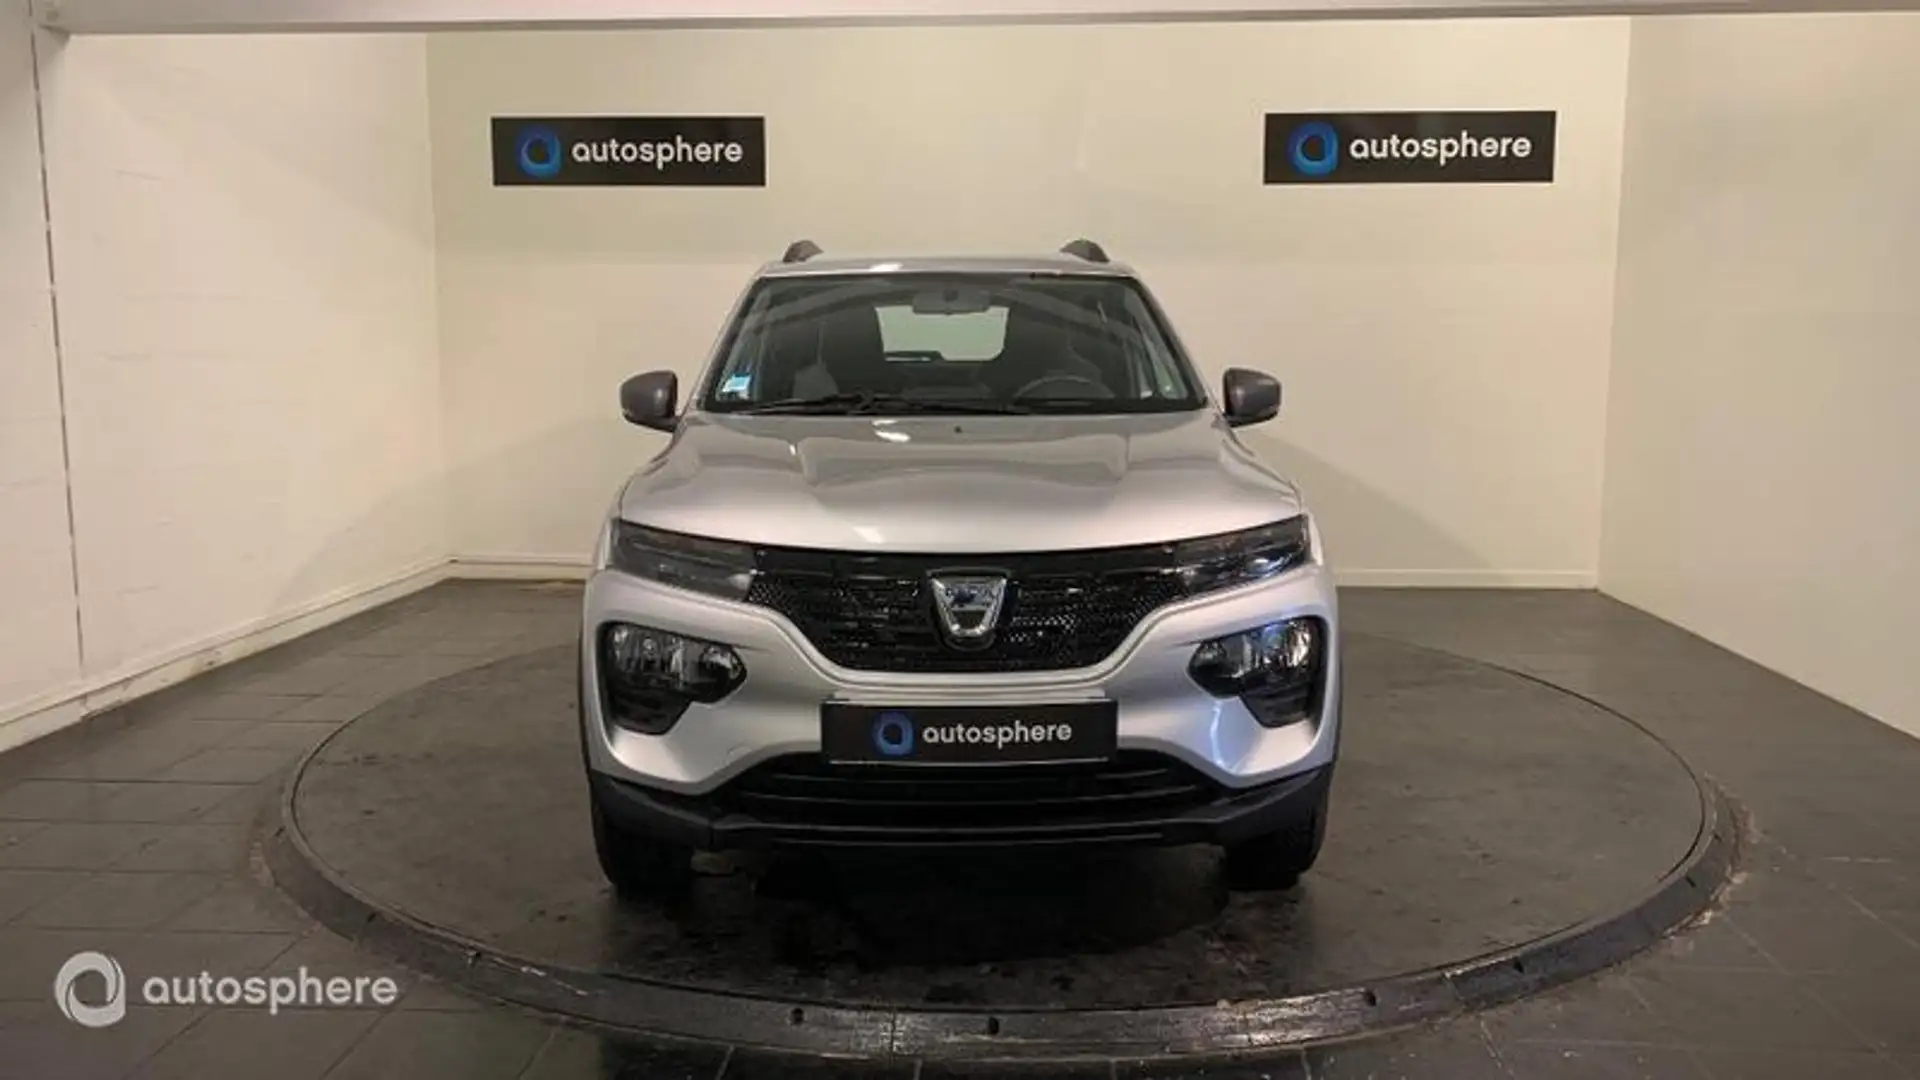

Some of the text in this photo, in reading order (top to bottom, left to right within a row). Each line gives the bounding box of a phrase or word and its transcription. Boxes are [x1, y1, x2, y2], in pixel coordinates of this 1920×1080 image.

[572, 135, 743, 169] autosphere
[1350, 130, 1531, 166] autosphere
[923, 720, 1072, 749] autosphere
